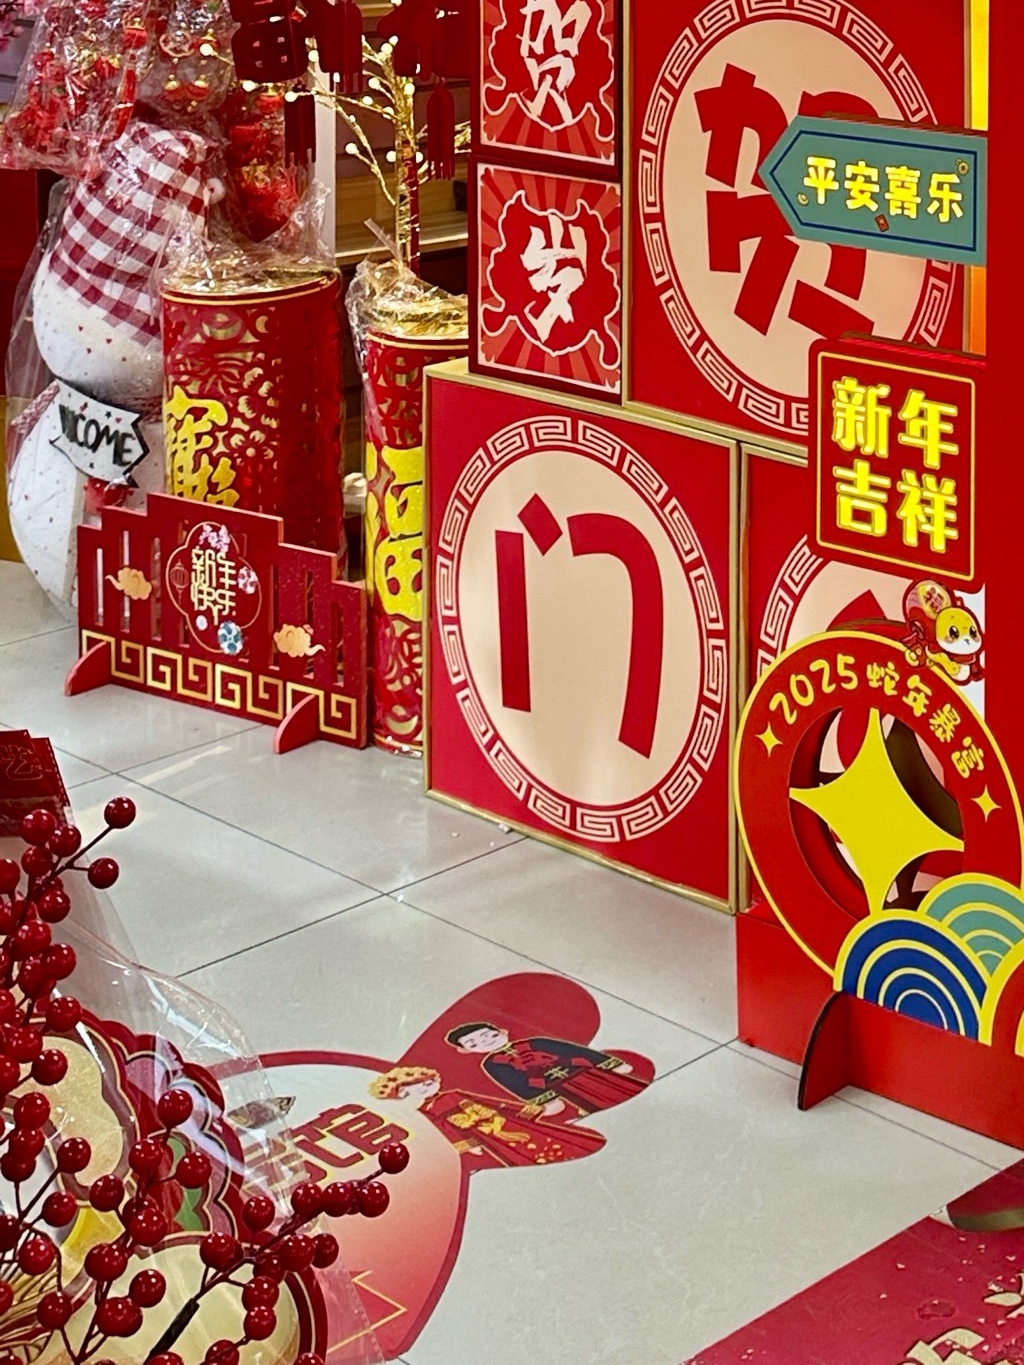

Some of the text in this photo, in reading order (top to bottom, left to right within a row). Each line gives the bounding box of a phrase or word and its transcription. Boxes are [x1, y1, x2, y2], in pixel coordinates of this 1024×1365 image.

[803, 155, 966, 224] 平安喜乐
[521, 212, 588, 343] 岁
[831, 375, 961, 469] 新年
[832, 461, 961, 555] 吉祥
[494, 492, 663, 759] 门
